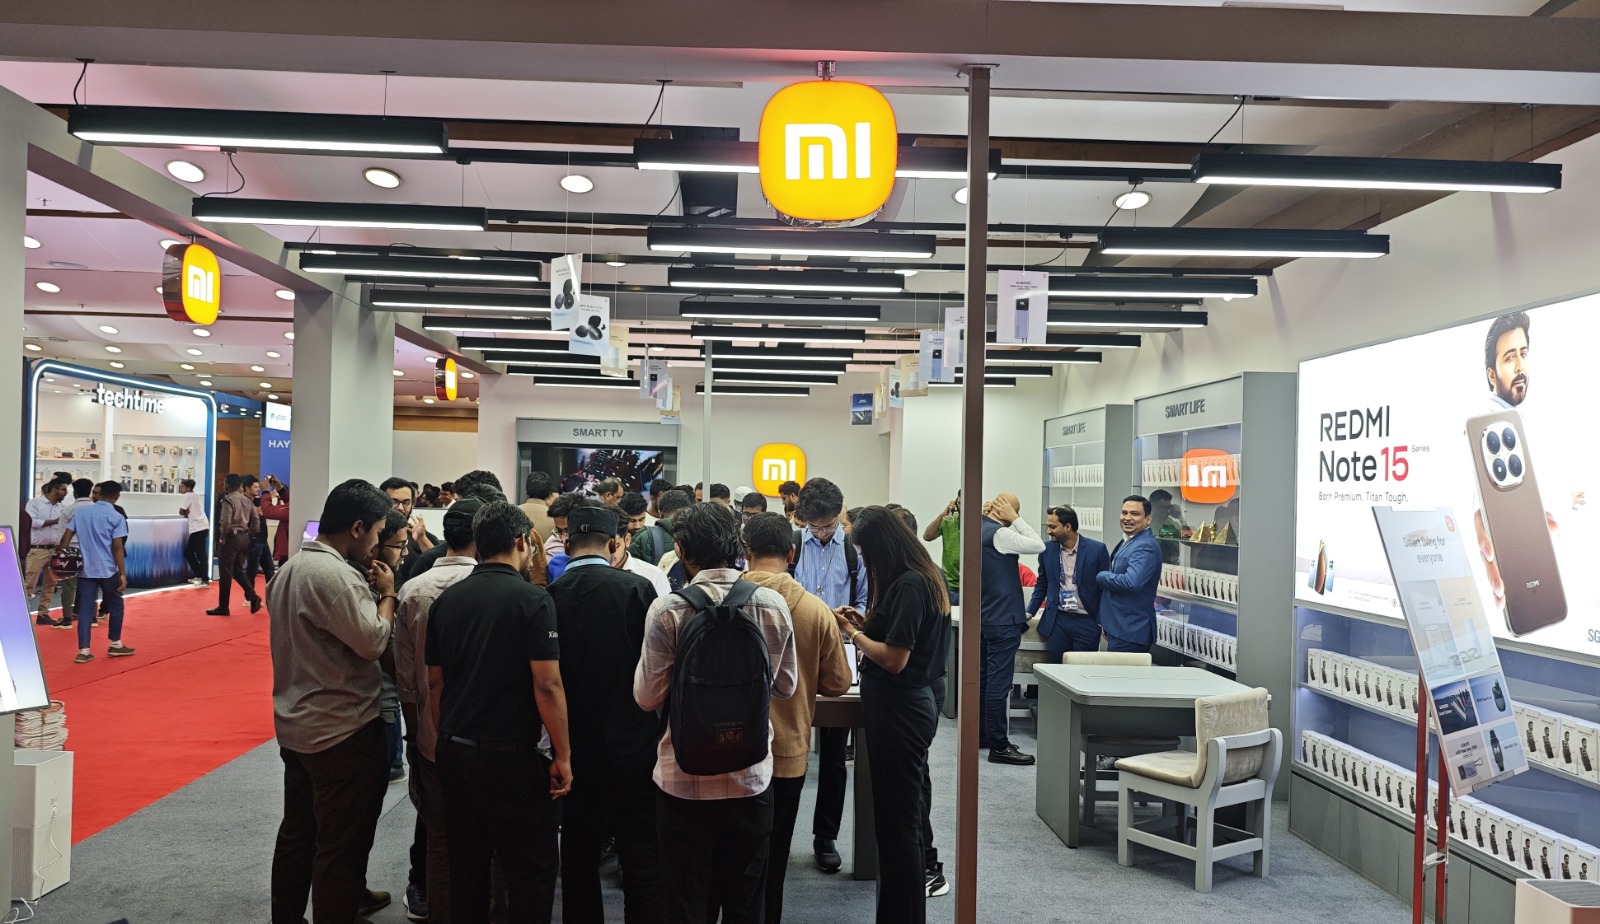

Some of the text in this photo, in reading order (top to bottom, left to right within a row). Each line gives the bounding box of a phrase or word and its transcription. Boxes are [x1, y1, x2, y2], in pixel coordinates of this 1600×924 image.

[97, 382, 165, 414] techtime
[1165, 398, 1205, 419] SMART LIFE
[1320, 405, 1390, 442] REDMI
[572, 428, 624, 437] SMART TV
[1319, 445, 1430, 482] Note 15 Series
[1318, 491, 1333, 501] Born
[1365, 491, 1383, 502] Titan
[1385, 491, 1409, 504] Tough.
[1402, 536, 1421, 548] Smart
[1416, 554, 1444, 565] everyone
